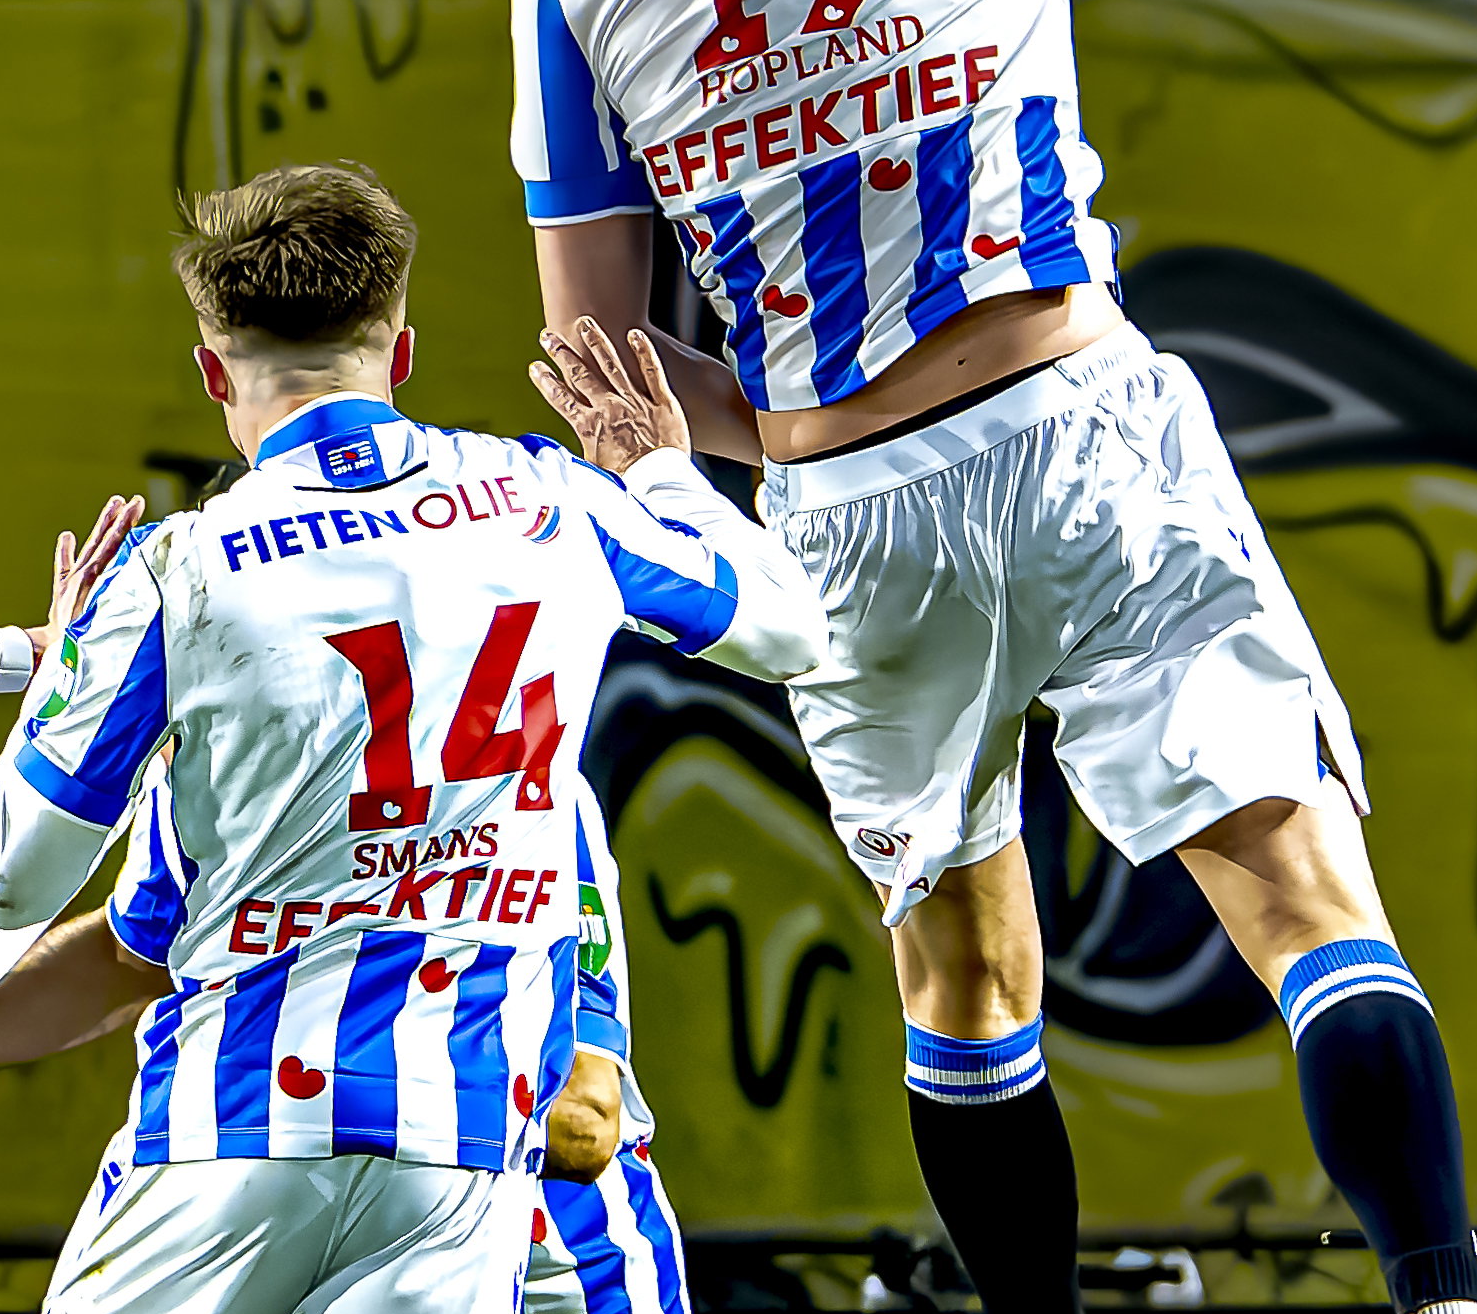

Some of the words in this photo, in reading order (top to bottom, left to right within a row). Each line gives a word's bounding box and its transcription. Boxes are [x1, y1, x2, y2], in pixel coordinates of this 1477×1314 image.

[699, 14, 926, 108] HOPLAND
[641, 43, 999, 198] EFFEKTIEF
[323, 601, 567, 832] 14
[351, 822, 500, 880] SMANS
[228, 867, 558, 955] EFKTIEF
